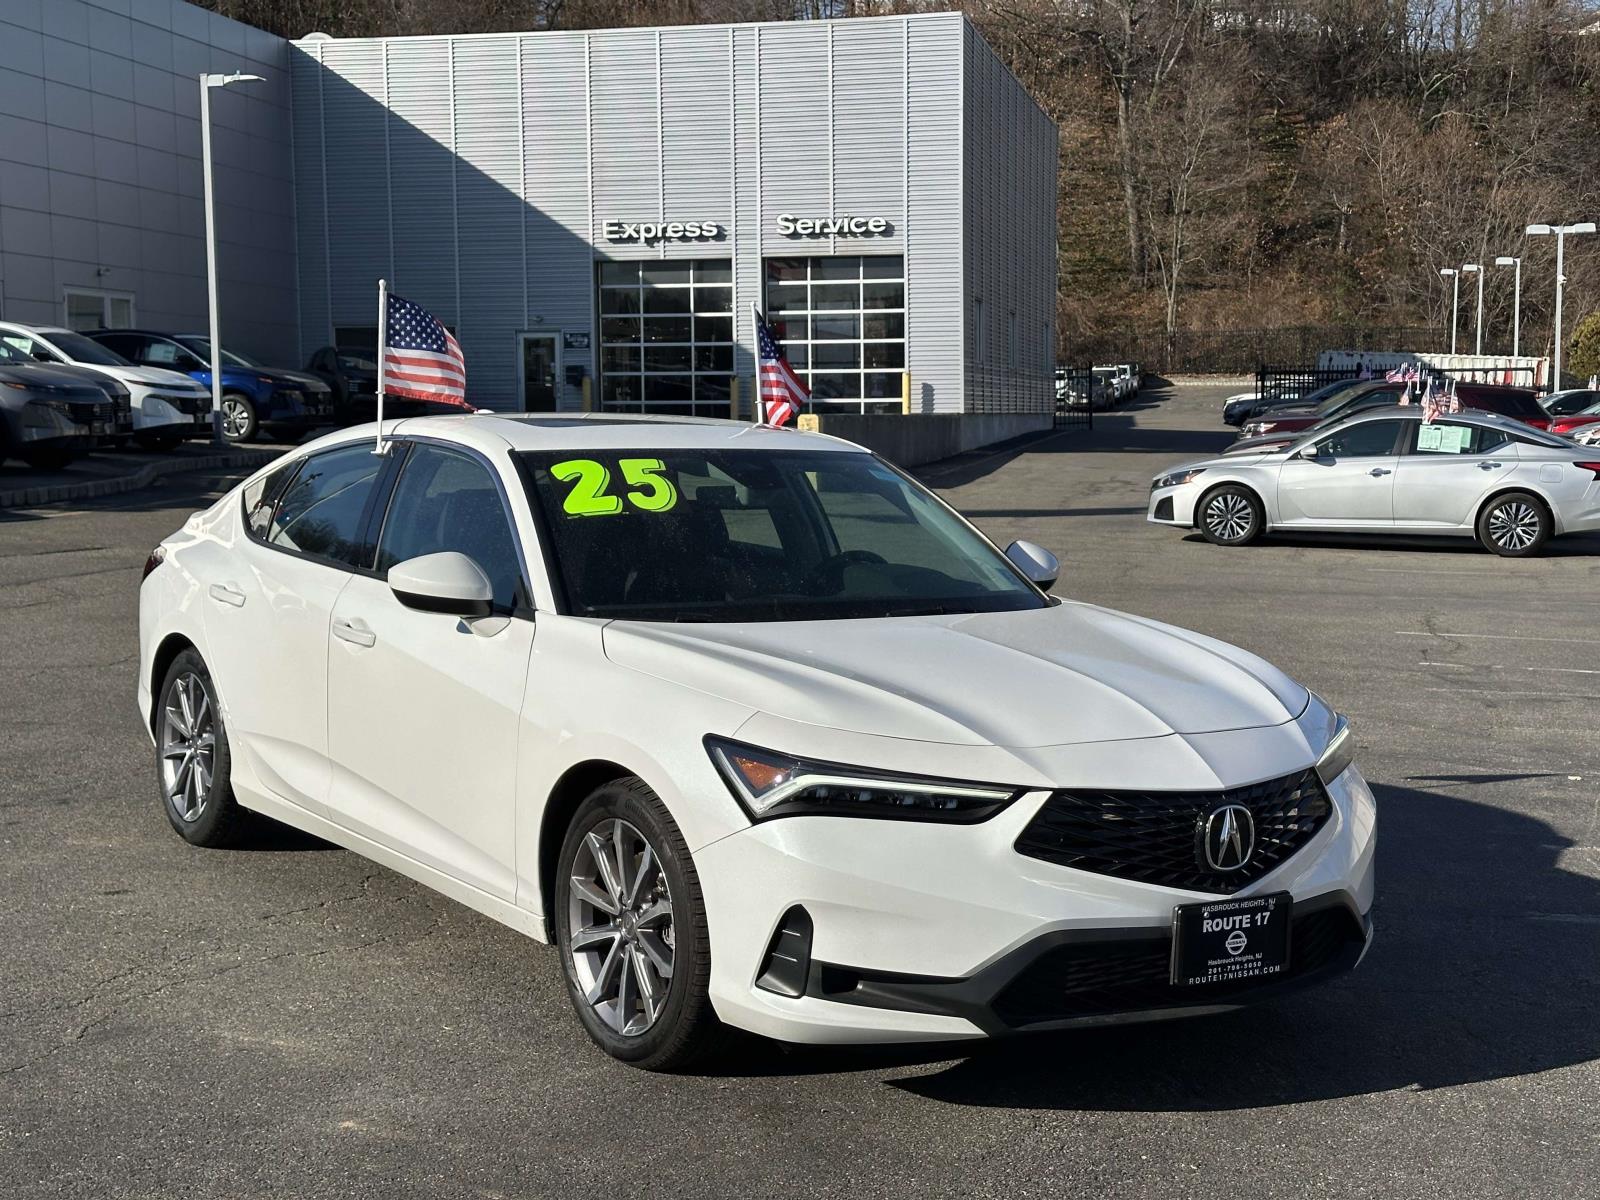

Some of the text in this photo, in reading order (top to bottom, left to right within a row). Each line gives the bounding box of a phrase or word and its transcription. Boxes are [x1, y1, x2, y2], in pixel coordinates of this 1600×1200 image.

[602, 213, 887, 243] Express Service
[550, 458, 678, 518] 25
[1202, 902, 1240, 913] HASBROUCK
[1268, 897, 1276, 905] NJ
[1202, 911, 1271, 933] ROUTE 17
[1188, 964, 1280, 985] ROUTE17NISSAN.COM
